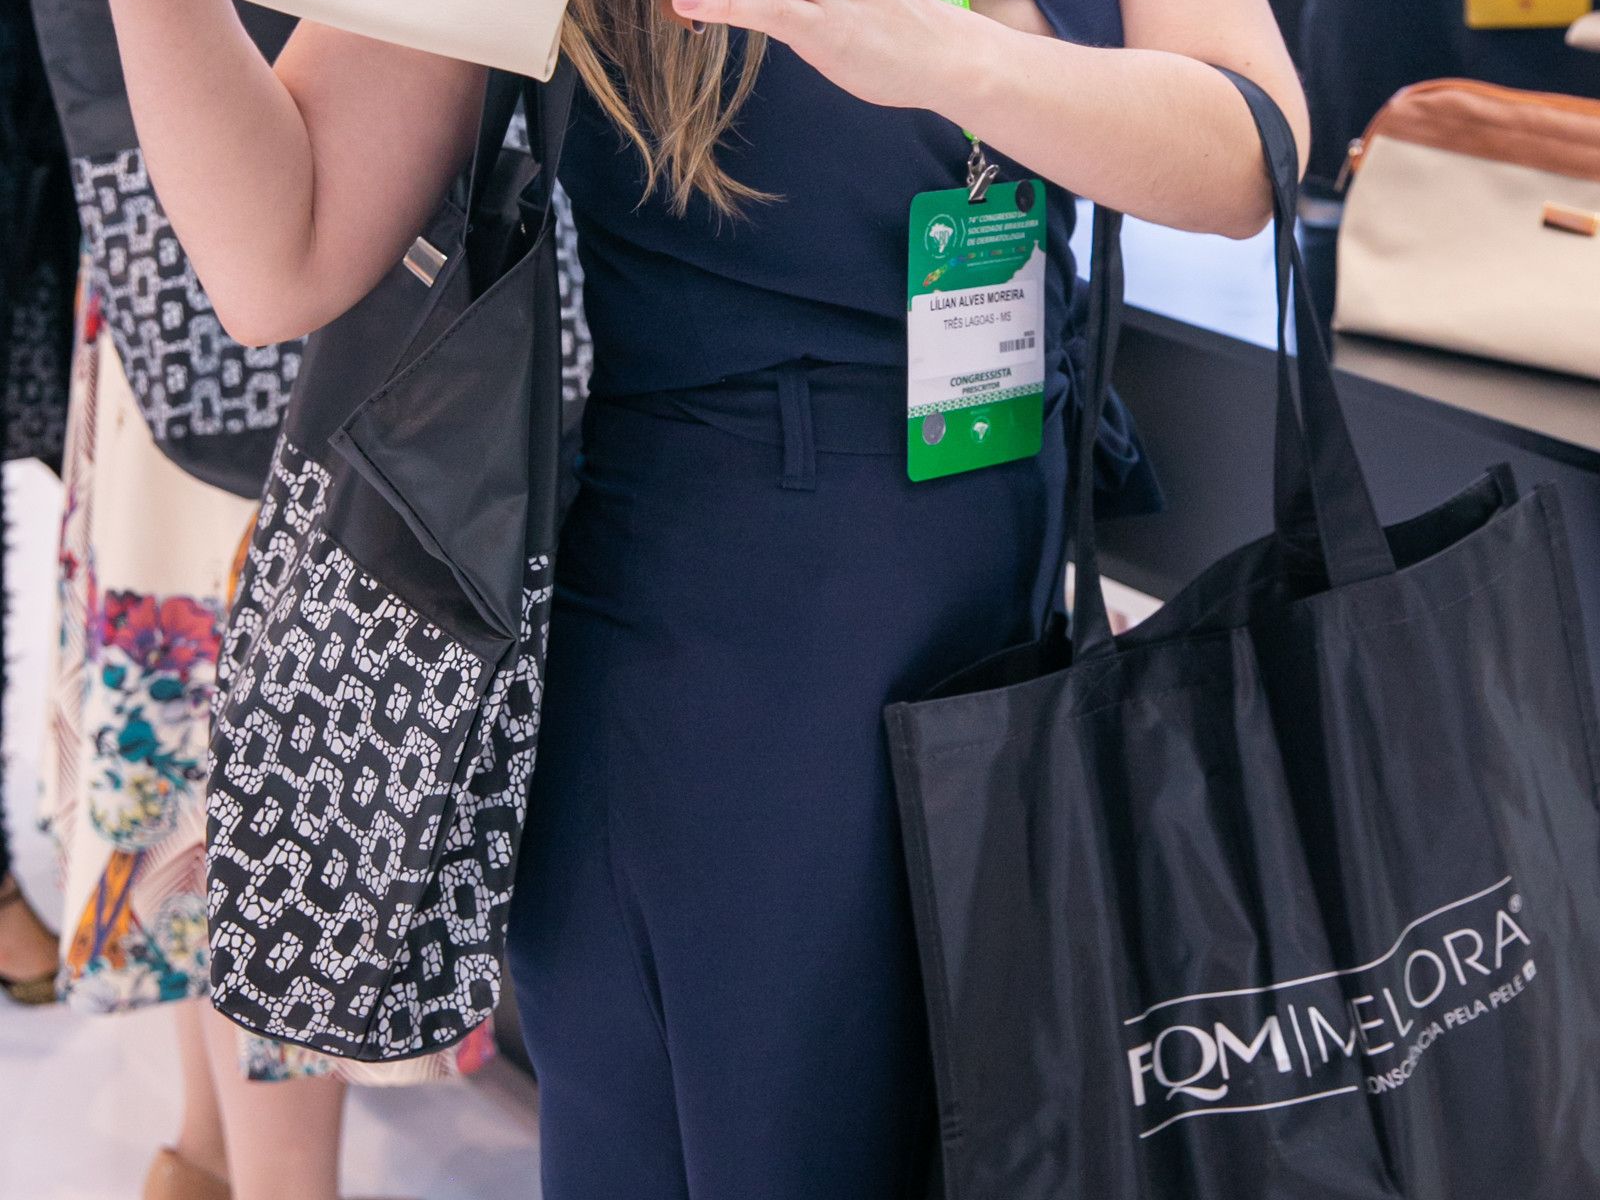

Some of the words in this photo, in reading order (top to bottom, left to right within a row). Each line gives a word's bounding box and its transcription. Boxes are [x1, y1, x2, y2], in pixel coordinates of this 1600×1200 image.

[958, 293, 985, 307] ALVES
[987, 288, 1025, 303] MOREIRA
[943, 316, 963, 331] TRÊS
[964, 313, 994, 328] LAGOAS
[1000, 311, 1012, 322] MS
[950, 367, 1012, 387] CONGRESSISTA
[962, 381, 1000, 394] PRESCRITOR
[1366, 1021, 1445, 1094] ONSCNCIA
[1442, 998, 1490, 1030] PELA
[1487, 974, 1526, 1009] PELE
